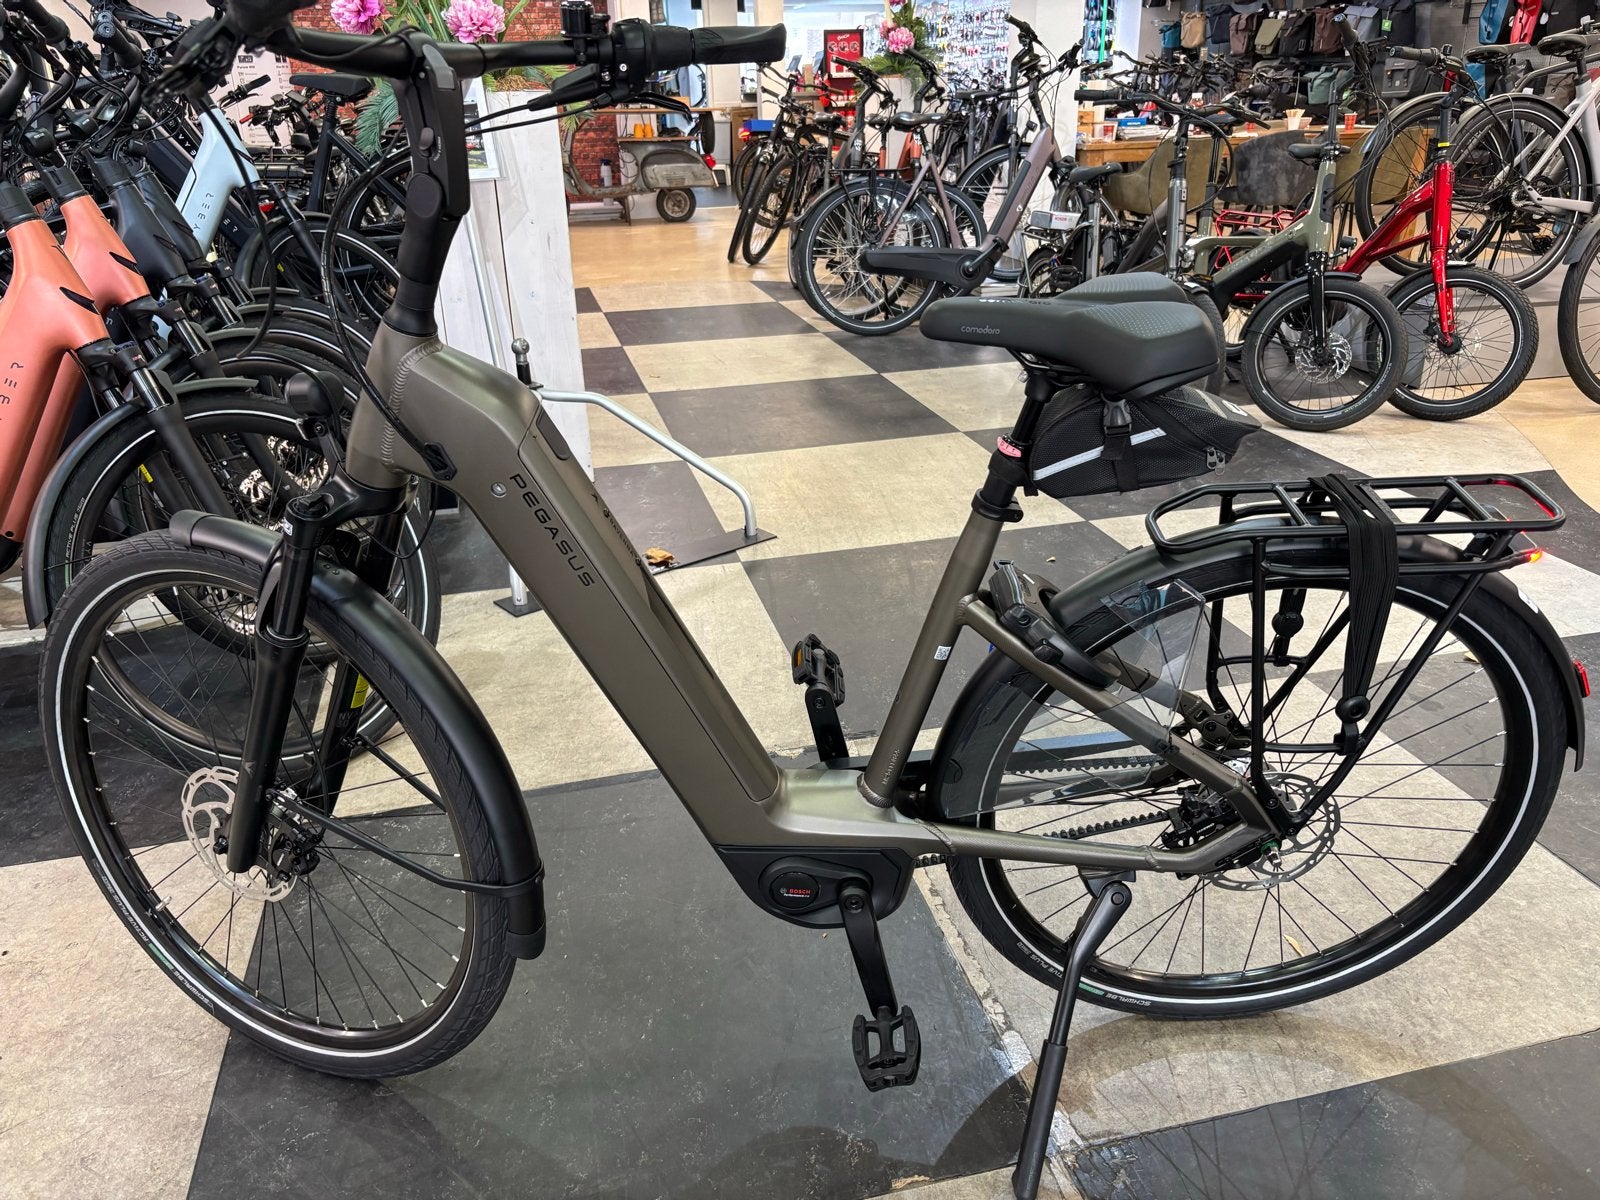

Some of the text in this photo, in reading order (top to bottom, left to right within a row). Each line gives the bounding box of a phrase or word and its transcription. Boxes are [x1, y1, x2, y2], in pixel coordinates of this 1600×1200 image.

[193, 192, 215, 230] YBER
[960, 324, 1000, 335] comodoro
[509, 473, 596, 587] PEGASUS
[1048, 966, 1064, 979] TIVE
[173, 969, 209, 1004] SCHWALBE
[1105, 992, 1152, 1007] SCHWALBE
